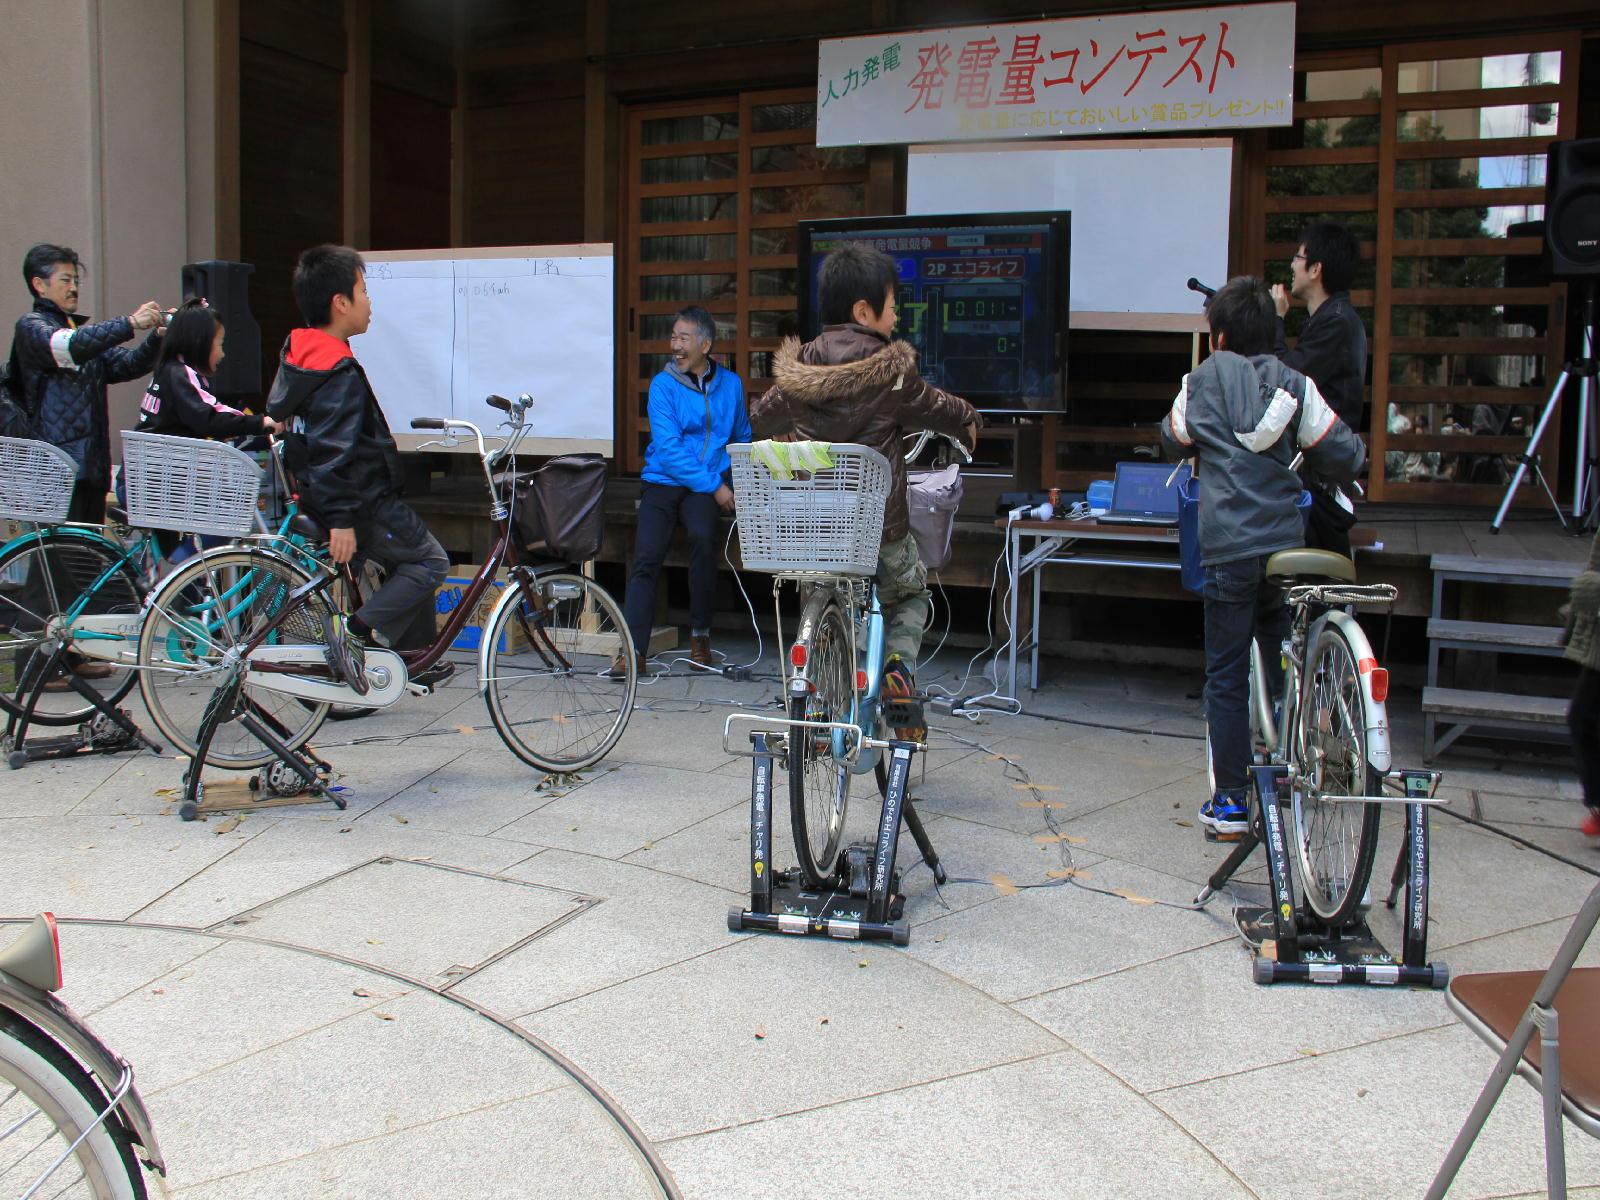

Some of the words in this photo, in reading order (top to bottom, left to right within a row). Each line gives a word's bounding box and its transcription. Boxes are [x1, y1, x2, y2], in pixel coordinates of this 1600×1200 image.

[821, 42, 901, 108] 人力発電
[905, 21, 1236, 114] 発電量コンテスト
[927, 263, 947, 277] 2P
[951, 260, 1018, 276] エコライフ
[1415, 780, 1422, 789] 6
